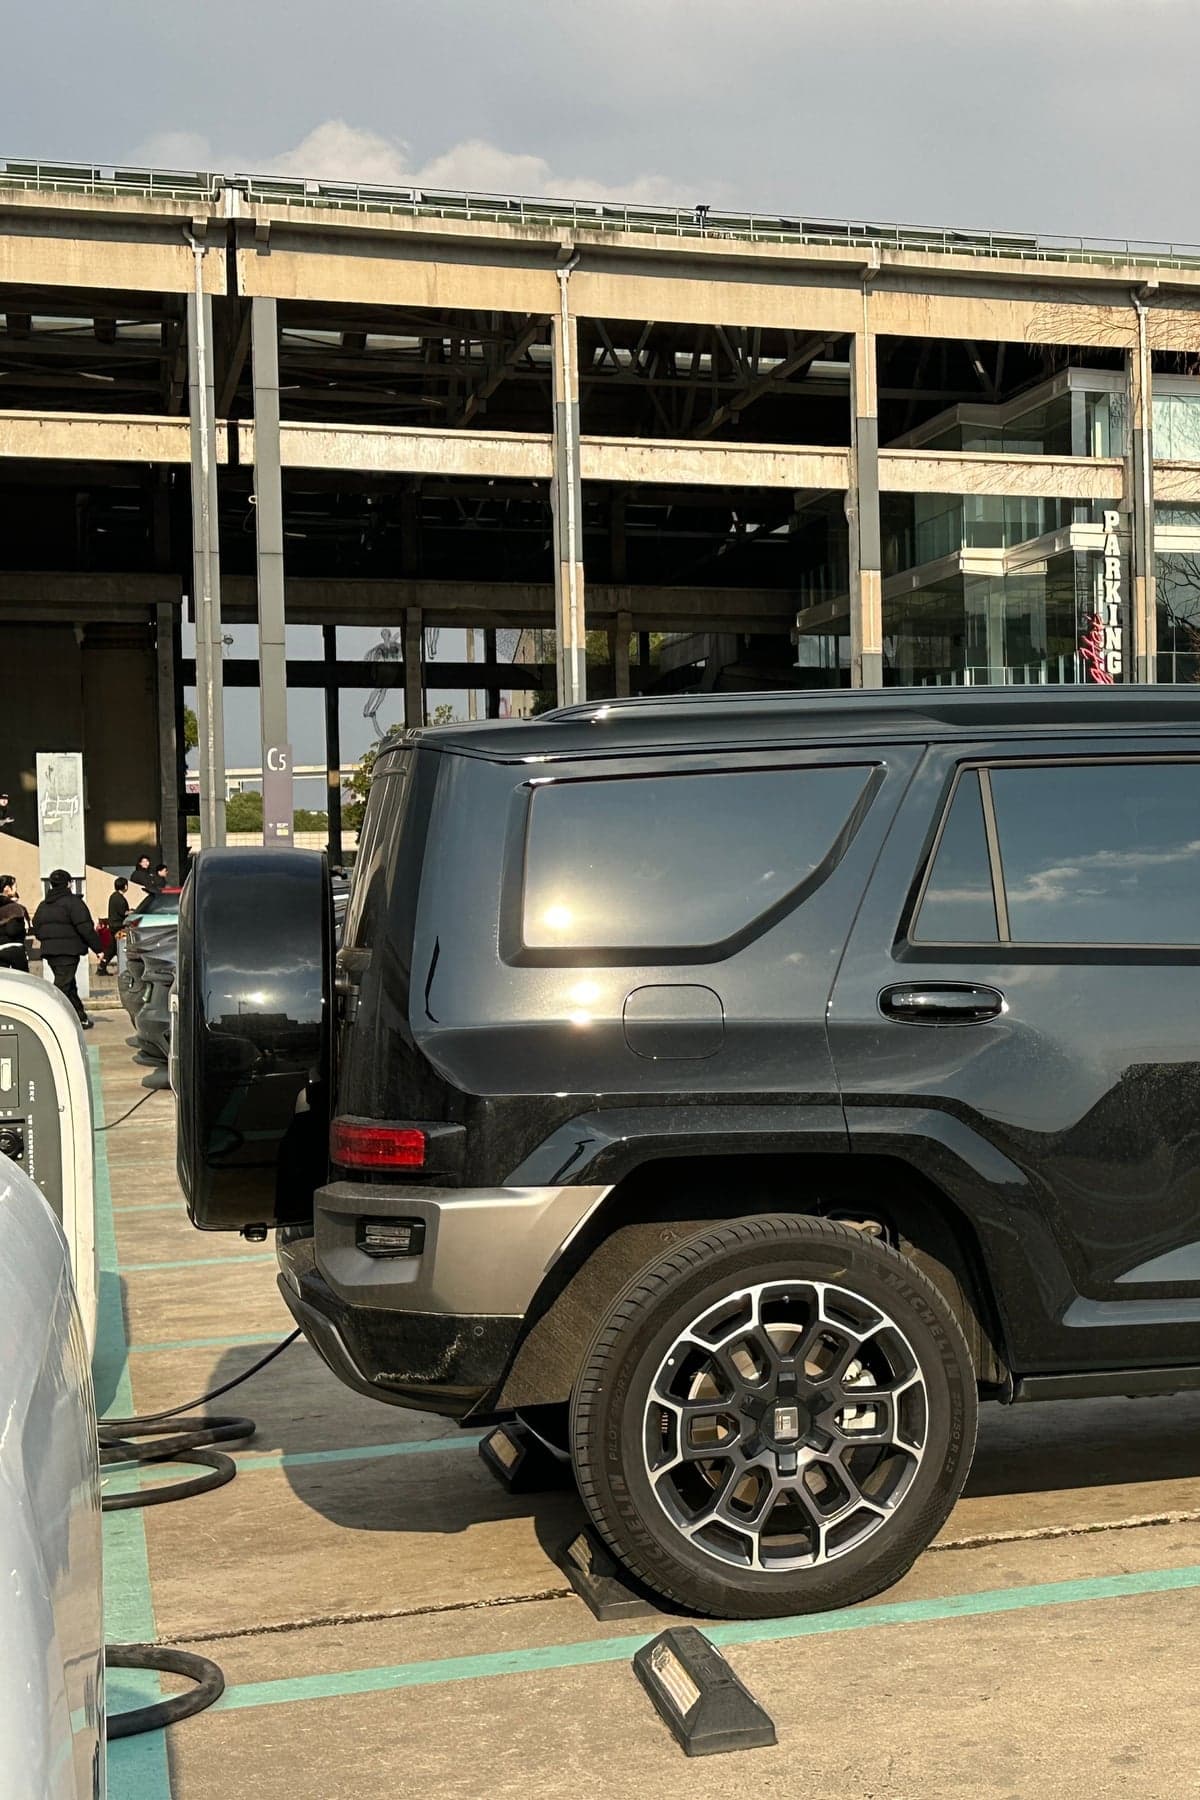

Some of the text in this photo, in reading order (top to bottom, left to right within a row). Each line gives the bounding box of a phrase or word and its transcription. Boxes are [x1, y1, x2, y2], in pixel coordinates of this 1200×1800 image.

[1103, 510, 1122, 674] PARKING
[267, 747, 287, 771] C5
[885, 1271, 960, 1379] MICHELIN
